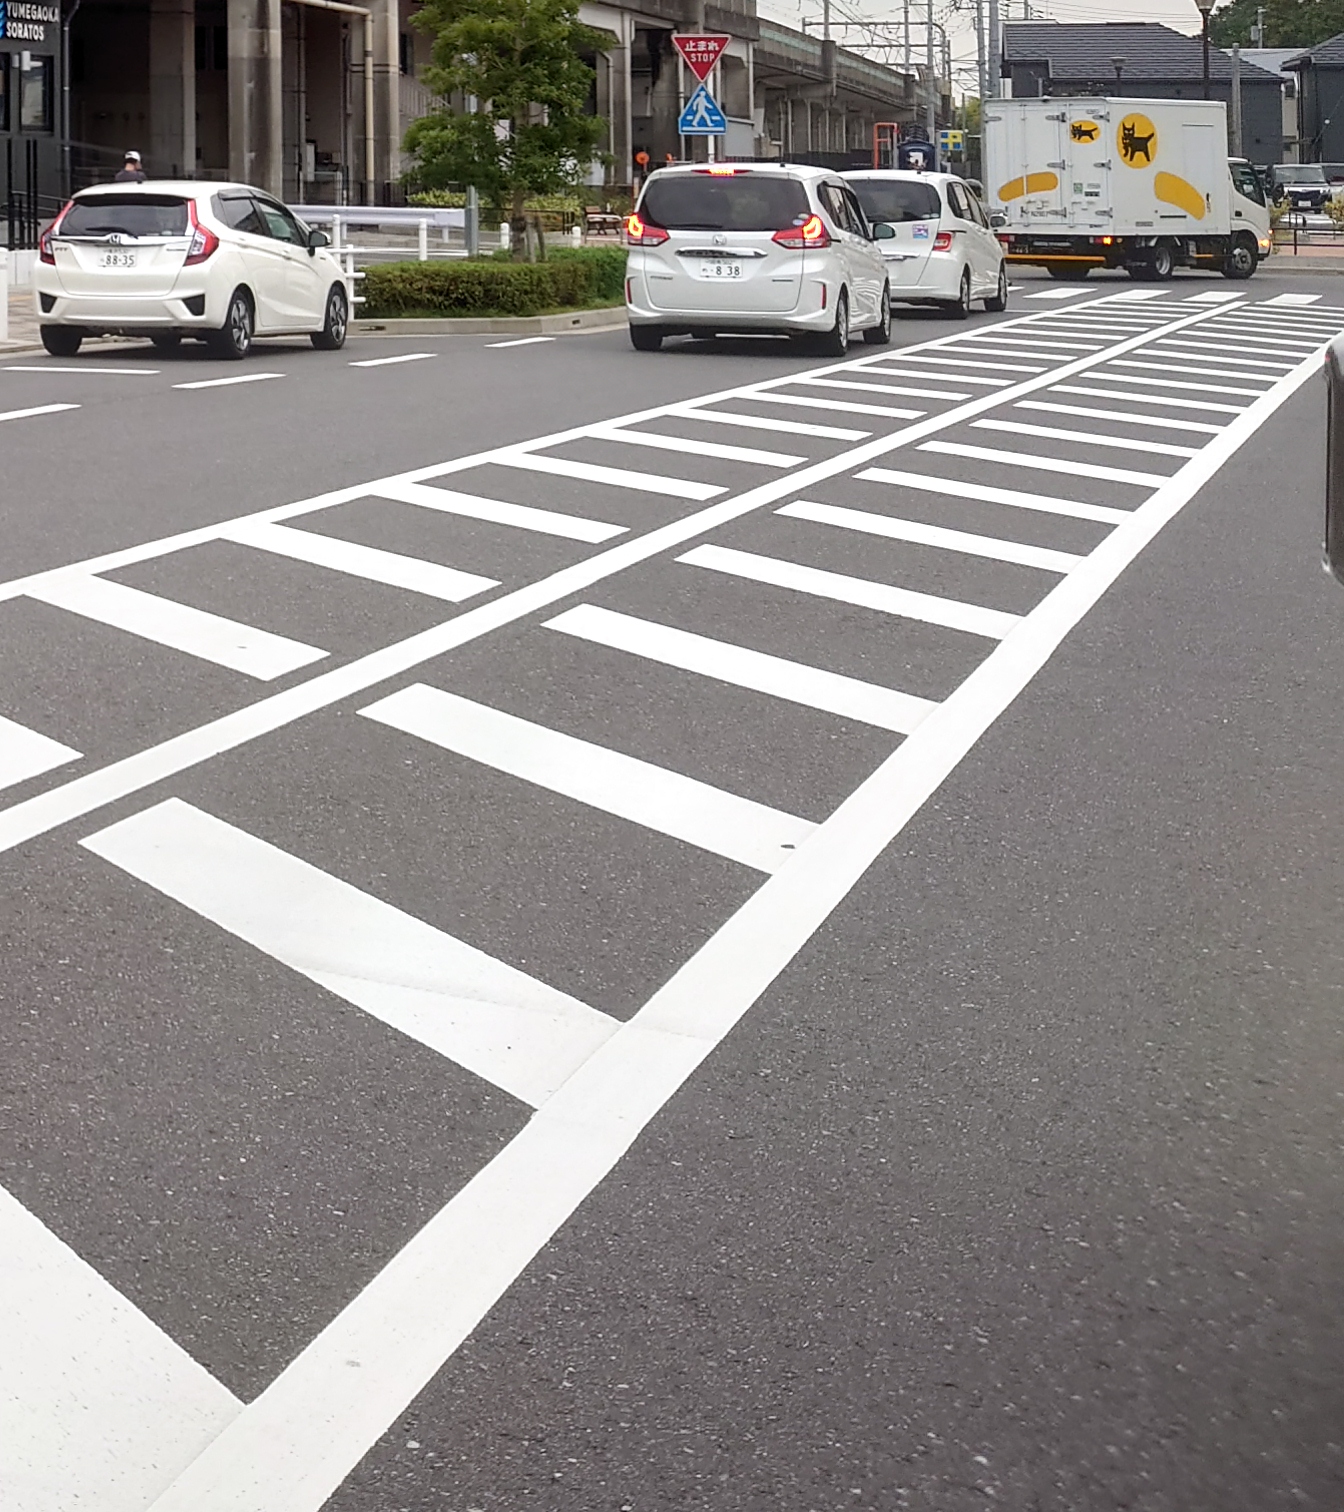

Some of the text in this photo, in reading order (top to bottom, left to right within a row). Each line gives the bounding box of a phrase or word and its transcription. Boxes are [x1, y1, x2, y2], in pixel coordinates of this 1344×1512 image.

[6, 1, 59, 23] YUMEGAOKA
[6, 21, 44, 41] SORATOS
[684, 40, 720, 52] 止まれ
[690, 53, 715, 62] STOP
